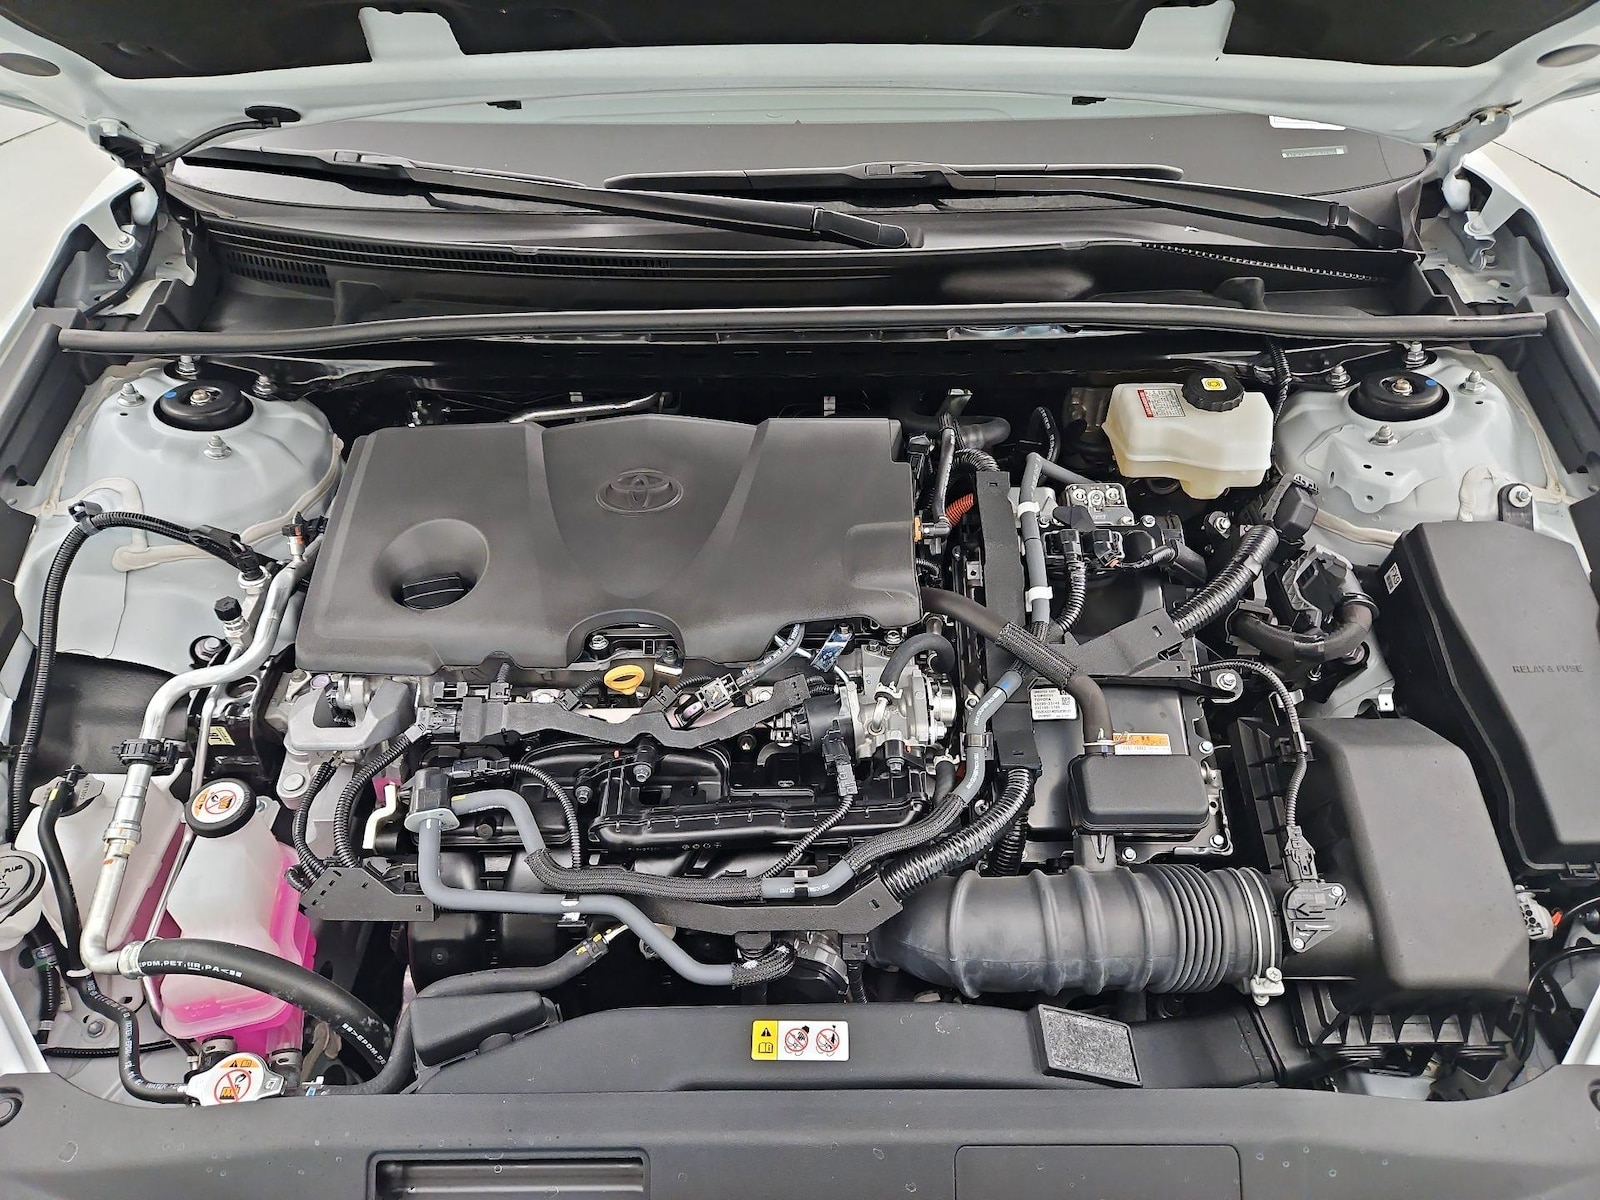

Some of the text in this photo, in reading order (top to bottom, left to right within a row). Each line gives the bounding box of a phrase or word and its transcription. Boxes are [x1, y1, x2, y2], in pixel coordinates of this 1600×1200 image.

[1512, 665, 1583, 673] RELAY & FUSE
[4, 864, 23, 873] FLUID
